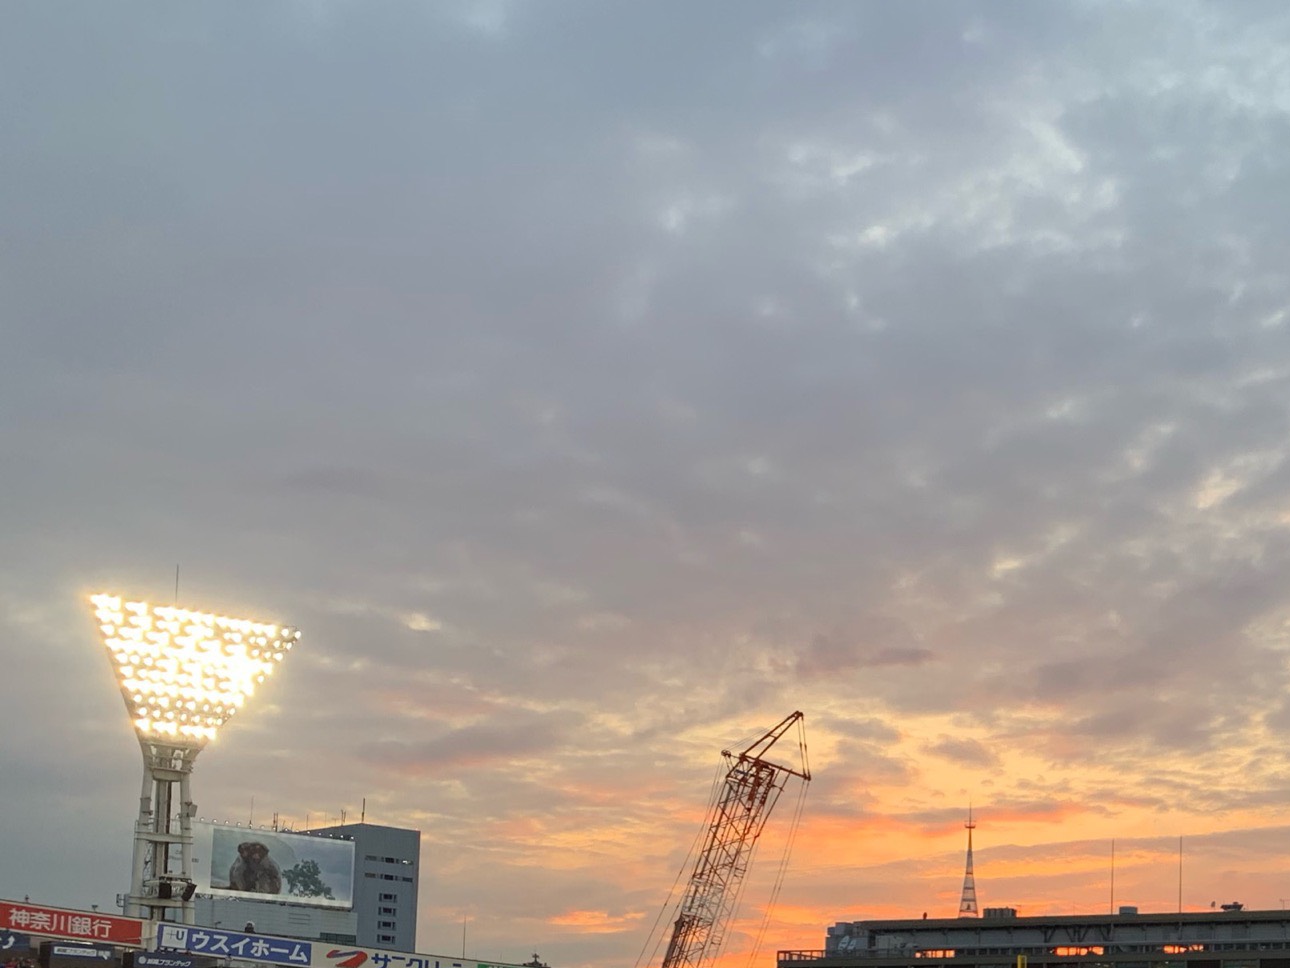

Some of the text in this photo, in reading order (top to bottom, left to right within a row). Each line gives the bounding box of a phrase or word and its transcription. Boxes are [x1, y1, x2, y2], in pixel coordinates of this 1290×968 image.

[8, 907, 112, 939] 神奈川銀行
[192, 931, 308, 963] ウスイホーム
